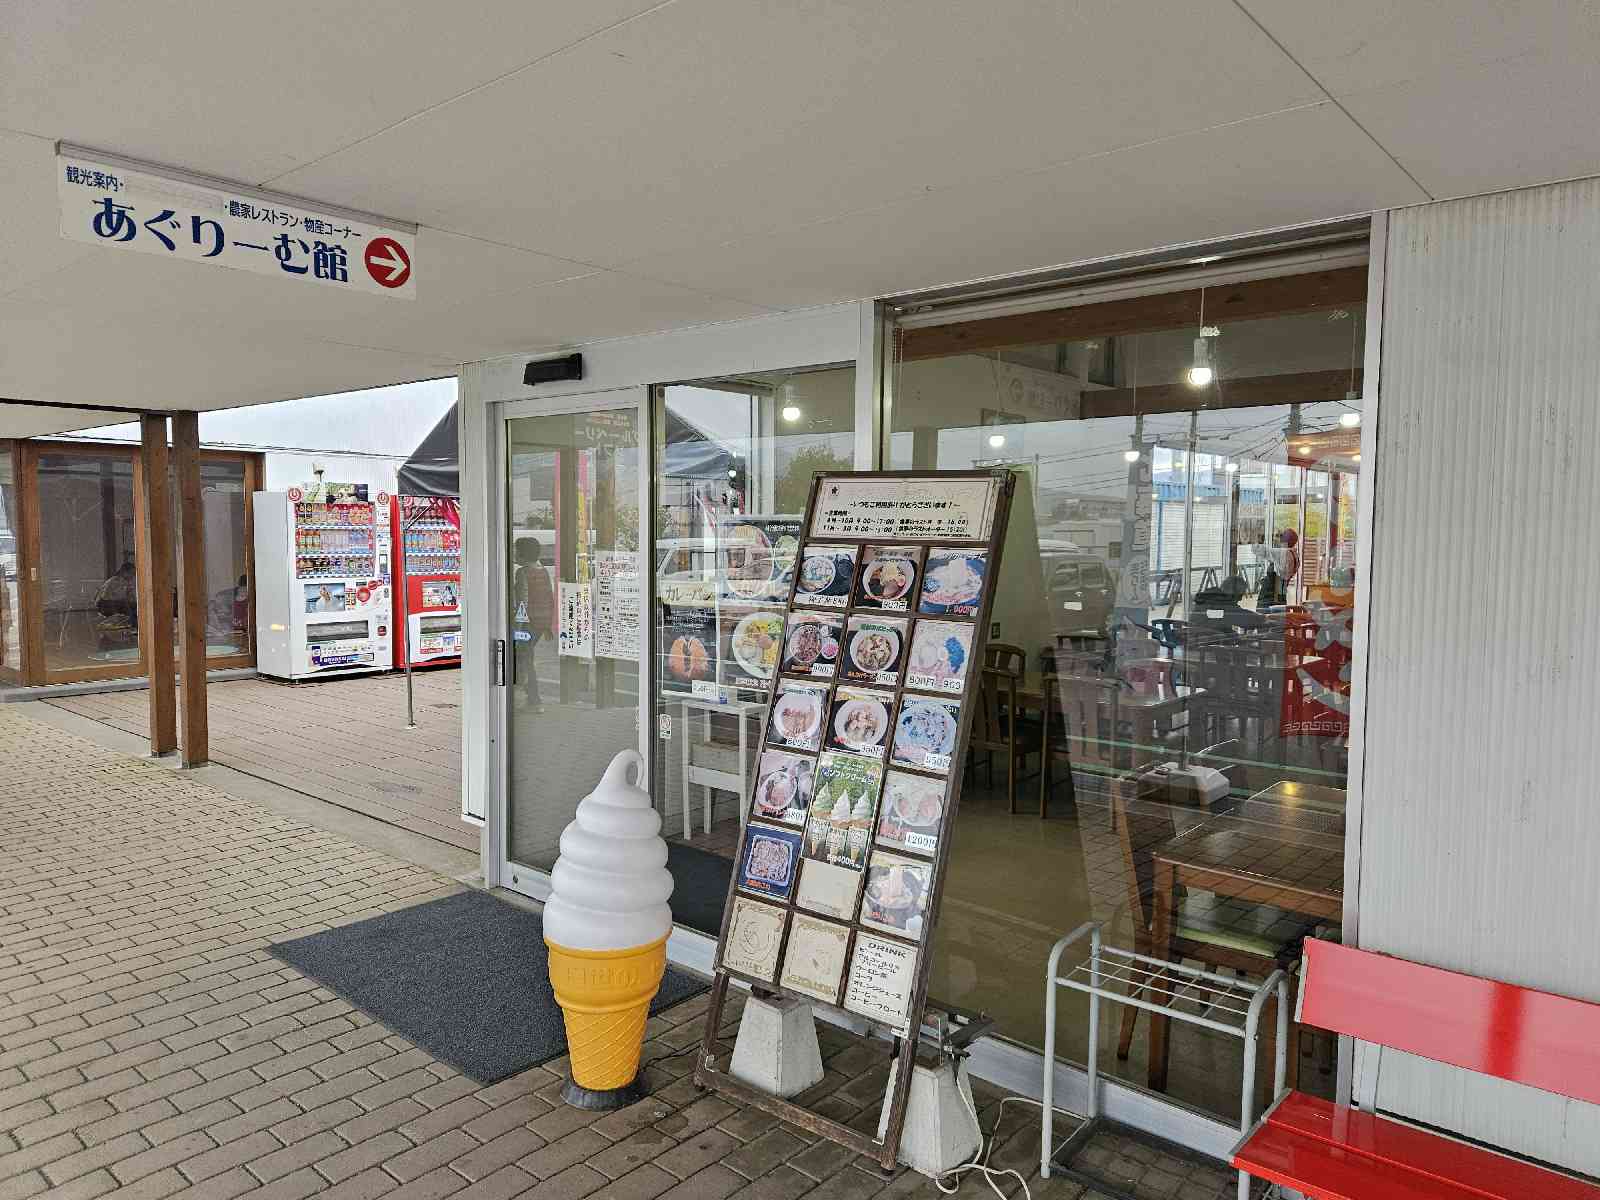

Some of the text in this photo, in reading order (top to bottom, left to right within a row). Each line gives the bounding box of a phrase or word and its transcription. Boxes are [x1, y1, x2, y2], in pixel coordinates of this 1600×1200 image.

[91, 198, 348, 283] あぐりーむ館
